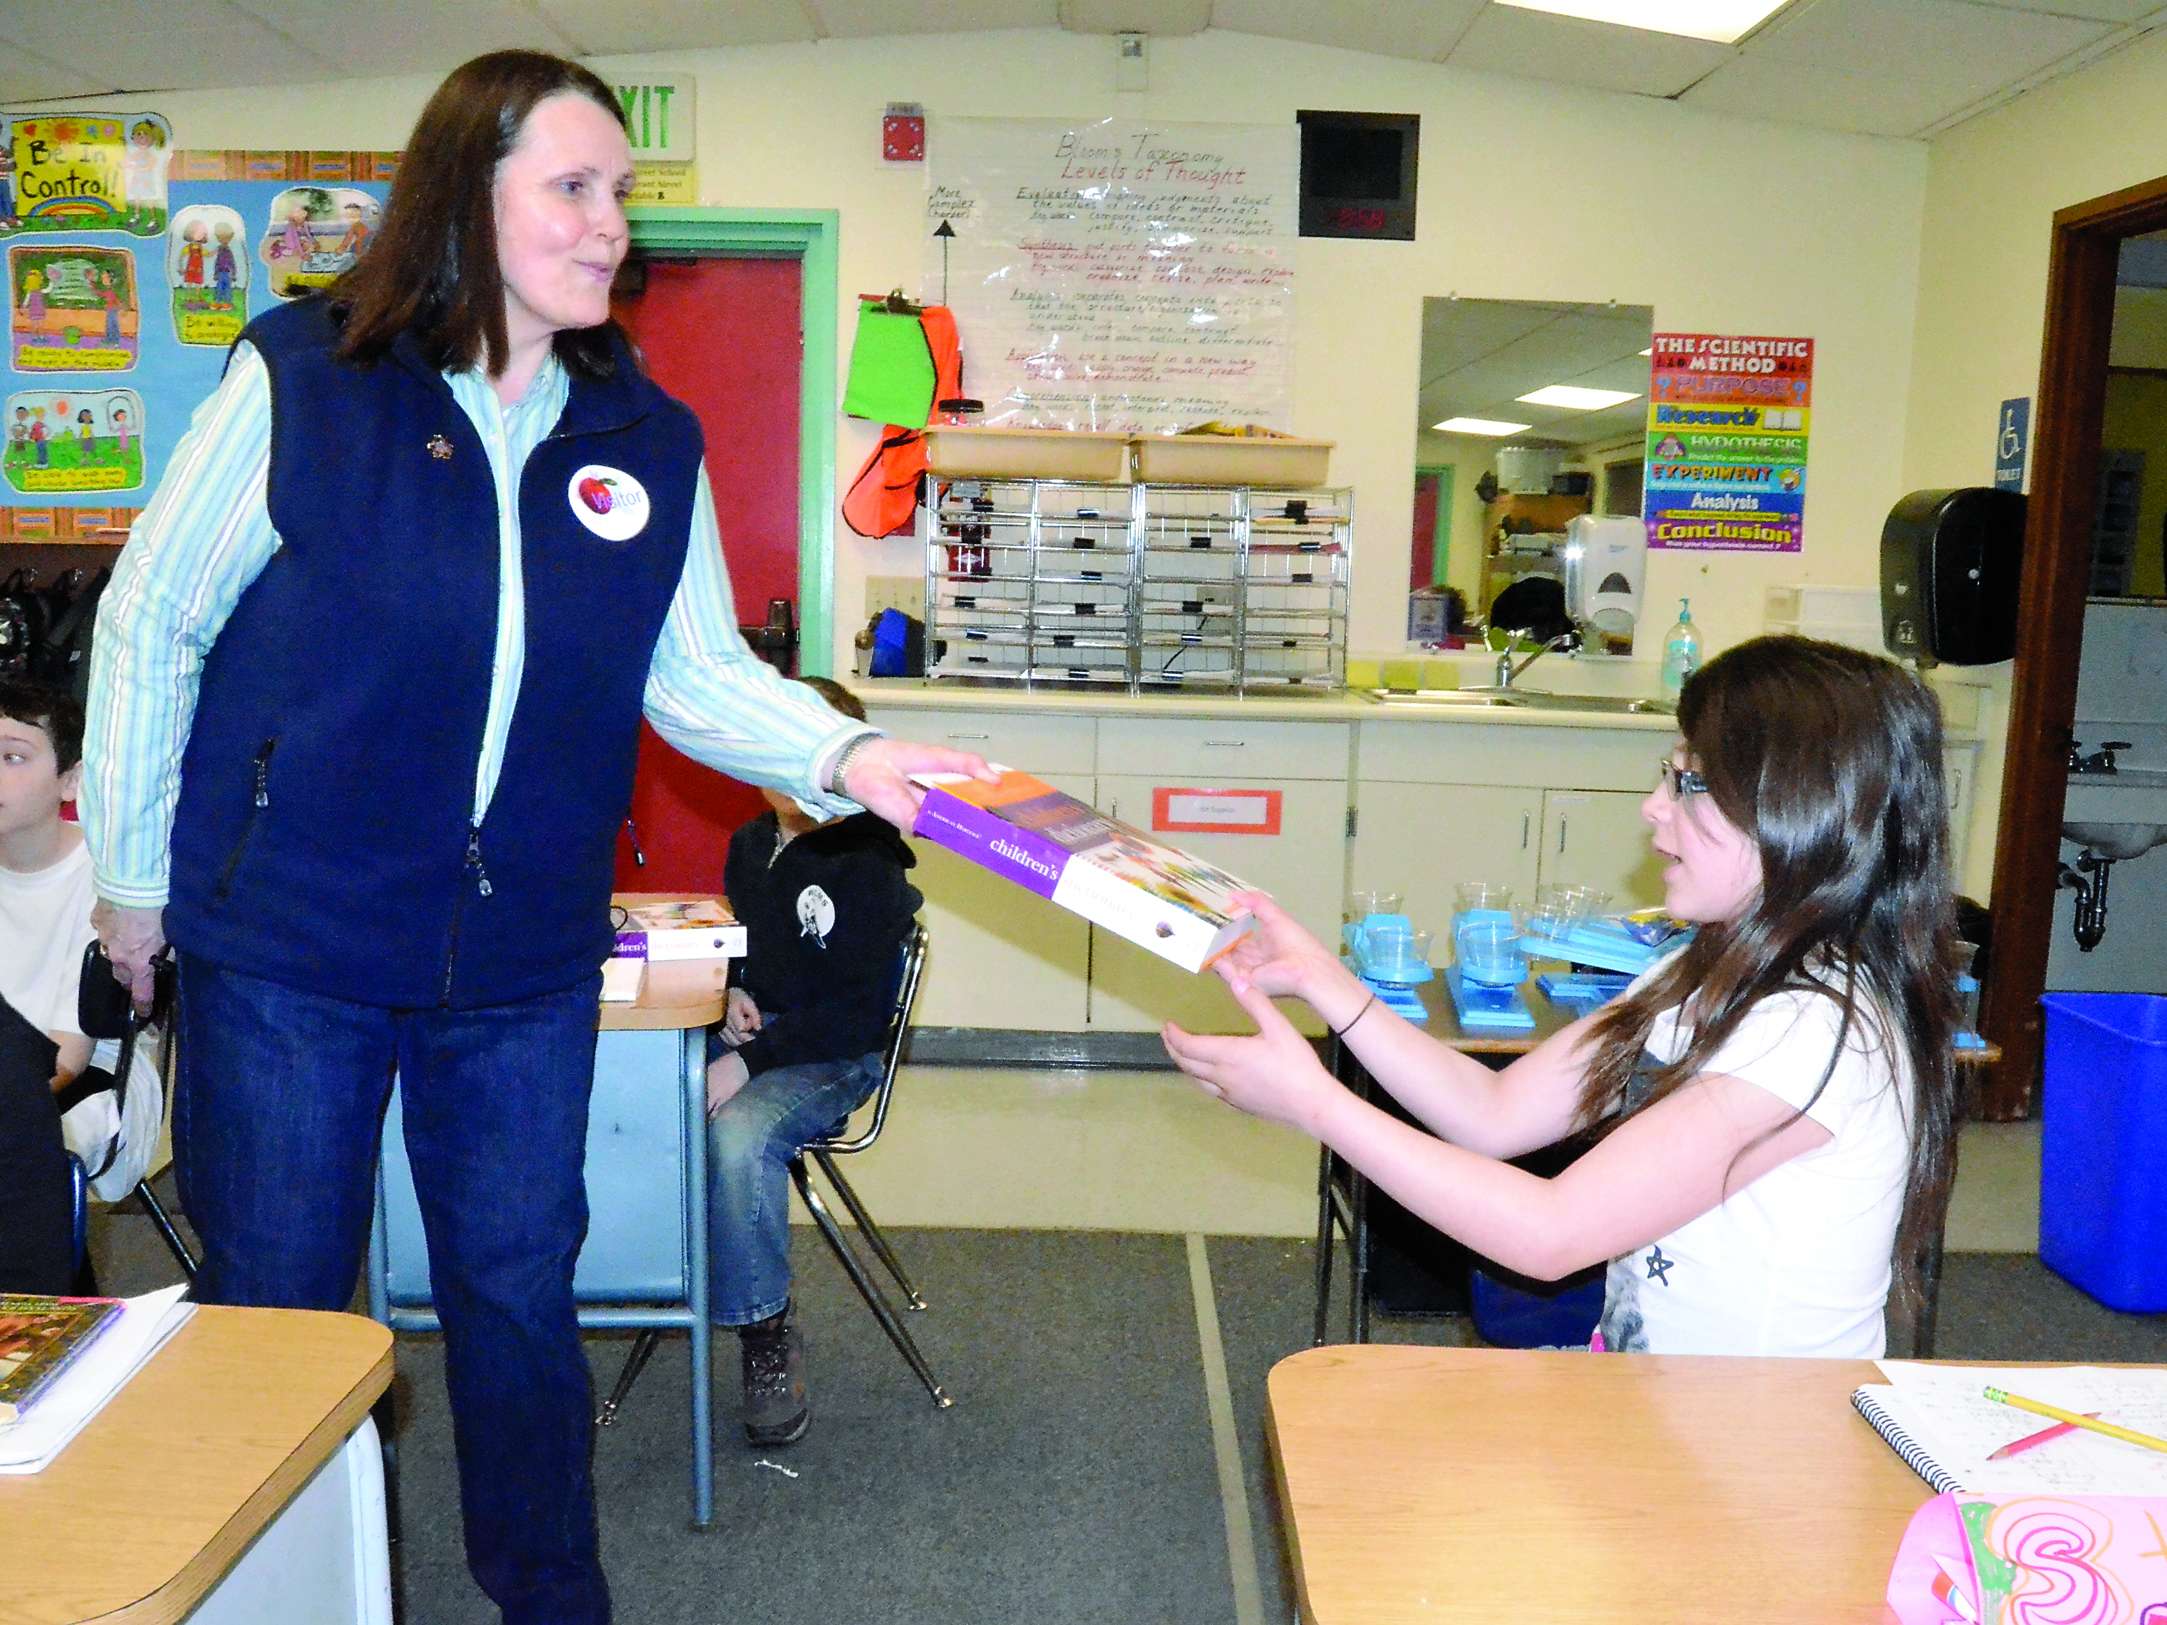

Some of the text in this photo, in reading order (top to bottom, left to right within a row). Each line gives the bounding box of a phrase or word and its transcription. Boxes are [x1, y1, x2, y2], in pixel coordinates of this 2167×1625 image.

[619, 86, 675, 148] XIT
[29, 140, 107, 165] Be In
[1131, 133, 1224, 170] Taxonomy
[21, 169, 118, 198] Control!
[1060, 158, 1247, 190] Levels of Thought
[1033, 200, 1053, 210] the
[1058, 200, 1098, 210] values
[1232, 194, 1274, 206] about
[1198, 242, 1214, 253] to
[1656, 337, 1808, 358] THE SCIENTIFIC
[1688, 356, 1776, 374] METHOD
[1675, 376, 1791, 397] PURPOSE
[1656, 404, 1758, 426] Research
[1690, 435, 1803, 453] HYPOTHESIS
[1651, 464, 1773, 483] EXPERIMENT
[591, 490, 641, 511] Visitor
[1691, 492, 1759, 511] Analysis
[1658, 522, 1792, 544] Conclusion
[989, 838, 1136, 920] children's dictionary
